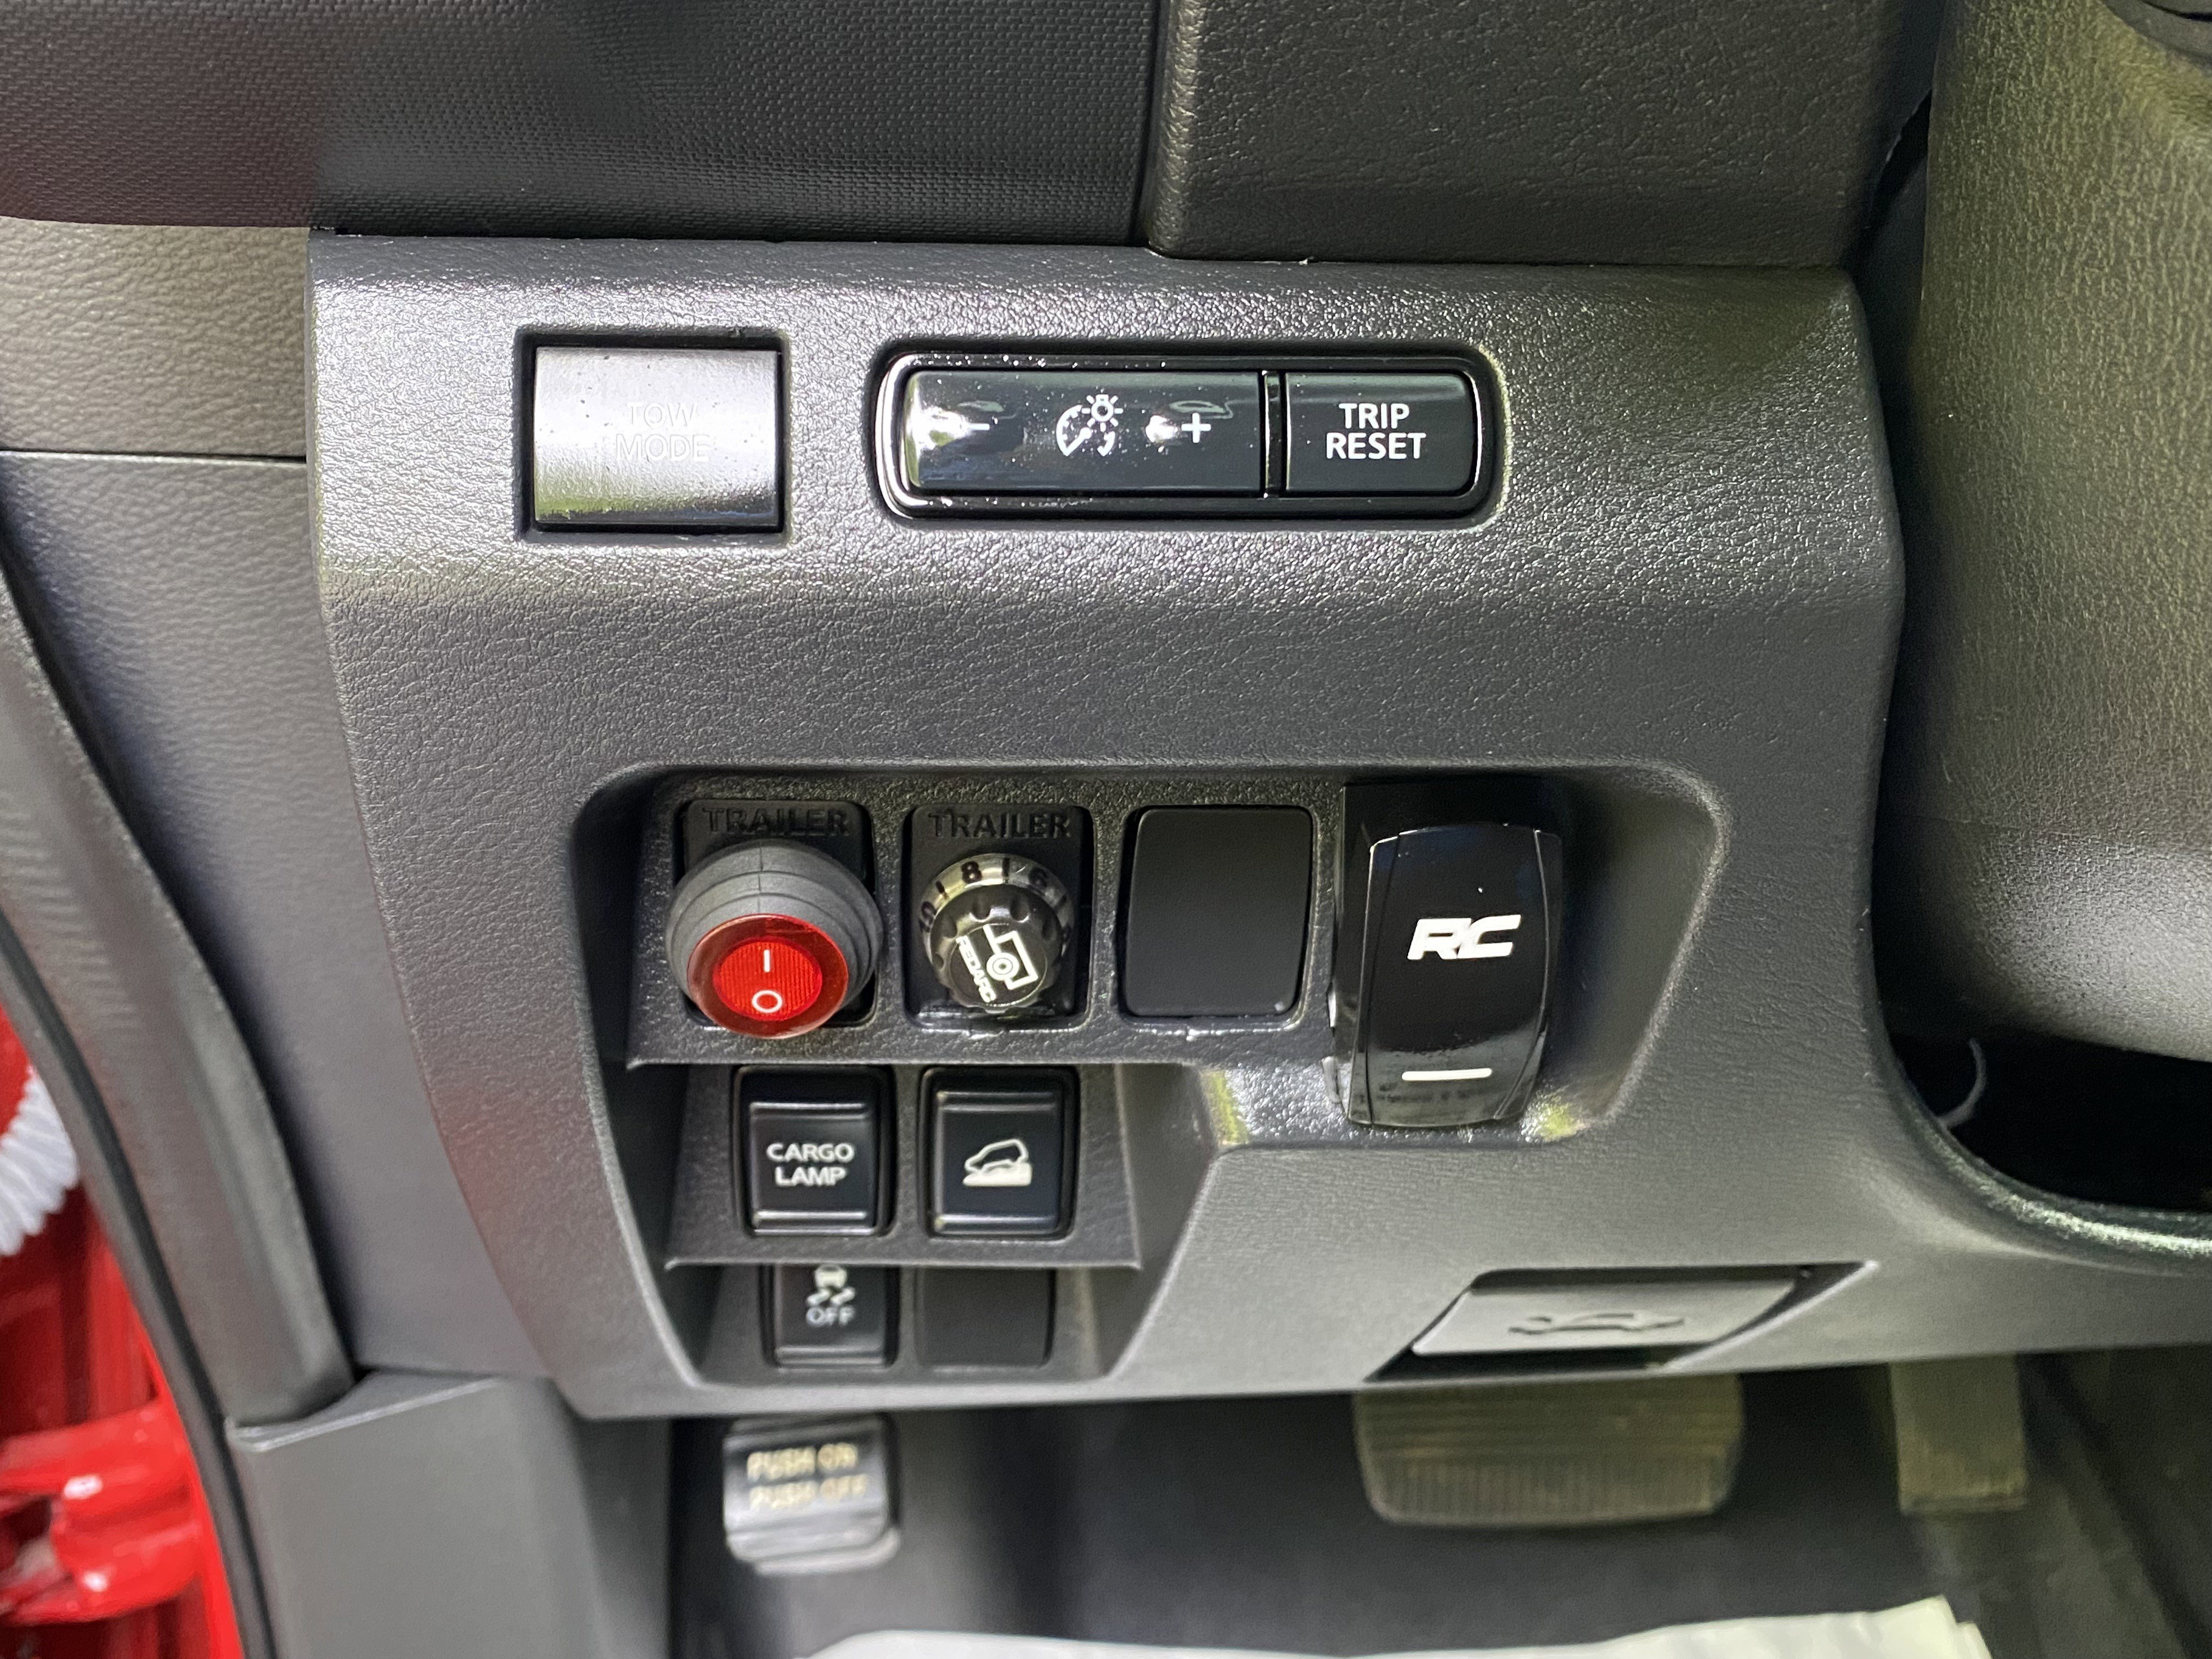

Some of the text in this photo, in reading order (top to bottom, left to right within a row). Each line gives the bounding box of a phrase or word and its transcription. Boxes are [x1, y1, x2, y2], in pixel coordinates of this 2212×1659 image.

[626, 402, 698, 428] TOW
[1338, 403, 1410, 428] TRIP
[616, 433, 709, 462] MODE
[1325, 432, 1427, 460] RESET
[703, 808, 849, 835] TRAILER
[928, 811, 1071, 838] TRAILER
[961, 861, 983, 884] 8
[1407, 915, 1521, 960] RC
[956, 935, 996, 1003] REDARC
[766, 1143, 854, 1163] CARGO
[775, 1166, 846, 1187] LAMP
[805, 1306, 855, 1327] OFF
[746, 1442, 859, 1482] PUSH ON
[749, 1474, 868, 1509] PUSH OFF
